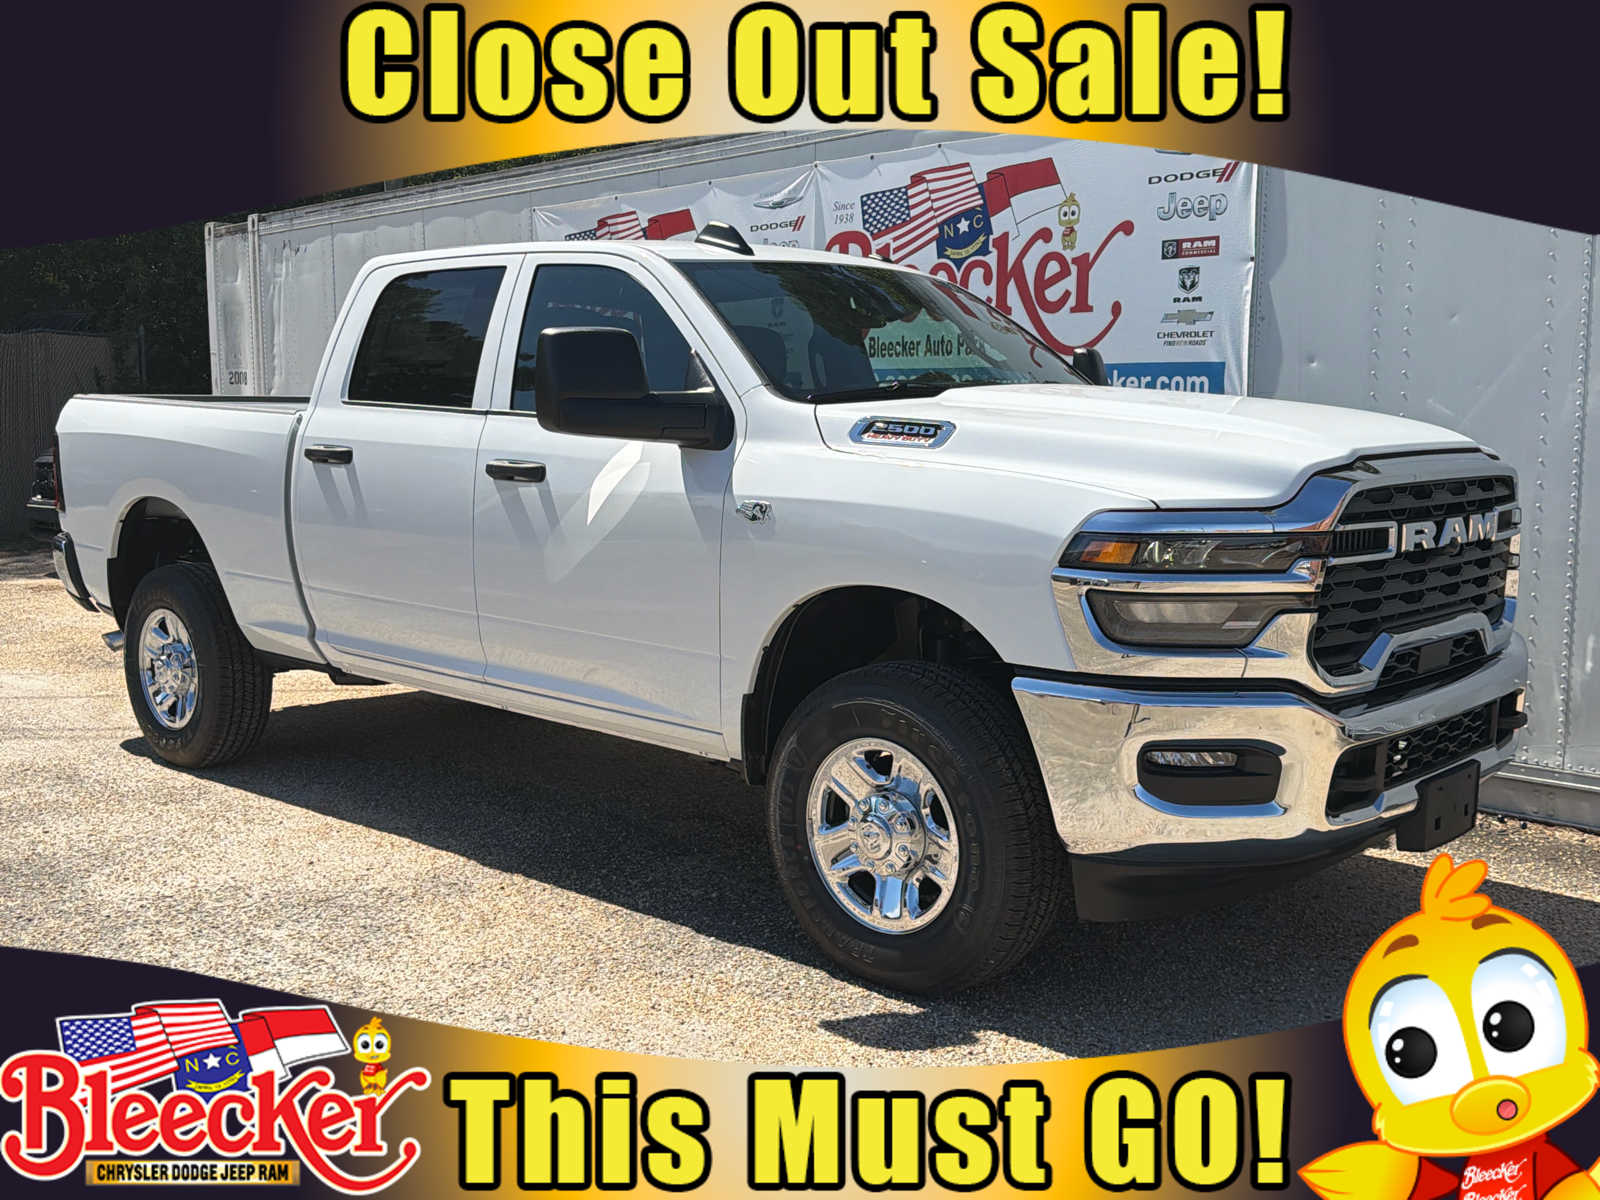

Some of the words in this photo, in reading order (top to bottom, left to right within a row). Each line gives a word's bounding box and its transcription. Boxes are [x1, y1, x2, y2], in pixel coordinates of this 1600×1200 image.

[1147, 167, 1226, 185] DODGE
[832, 200, 856, 212] Since
[1156, 191, 1228, 222] Jeep
[750, 219, 798, 232] DODGE
[833, 213, 855, 225] 1938
[1181, 239, 1217, 250] RAM
[1172, 296, 1203, 304] RAM
[1156, 330, 1216, 340] CHEVROLET
[868, 335, 921, 359] Bleecker
[924, 334, 953, 358] Auto
[871, 422, 937, 436] 2500
[1401, 511, 1499, 553] RAM
